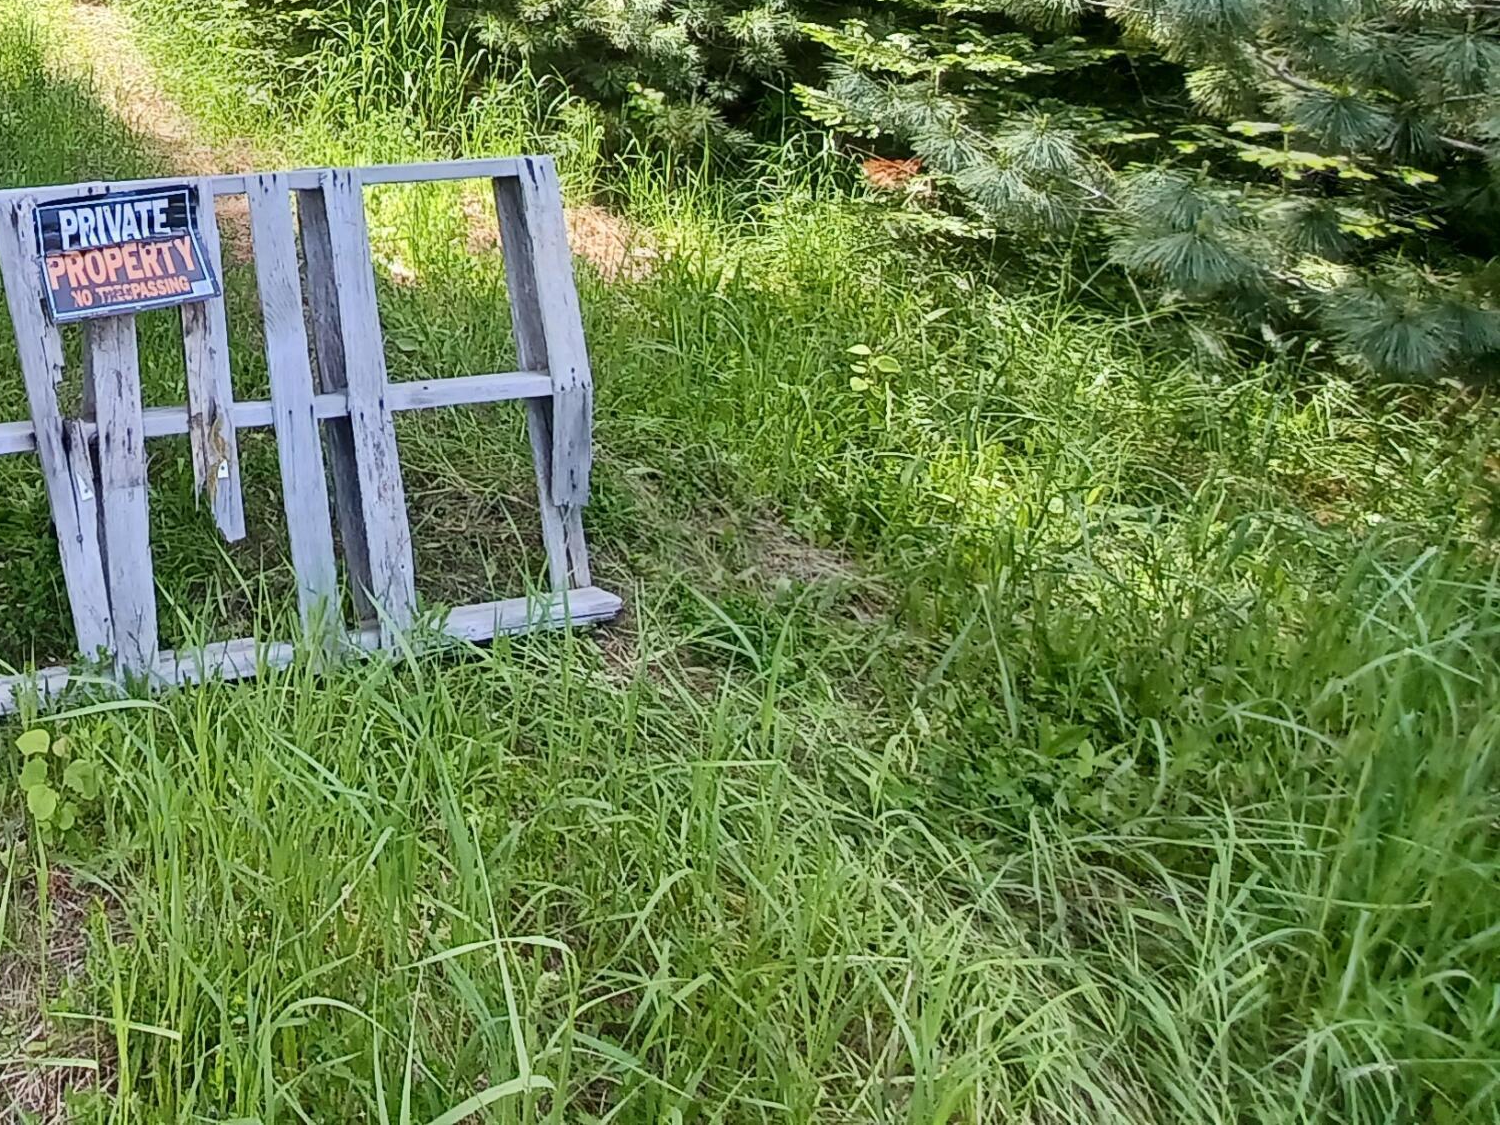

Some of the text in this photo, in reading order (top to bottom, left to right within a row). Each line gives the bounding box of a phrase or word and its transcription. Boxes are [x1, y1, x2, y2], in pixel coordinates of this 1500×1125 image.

[59, 198, 171, 250] PRIVATE
[47, 236, 195, 290] PROPERTY
[71, 289, 93, 308] NO
